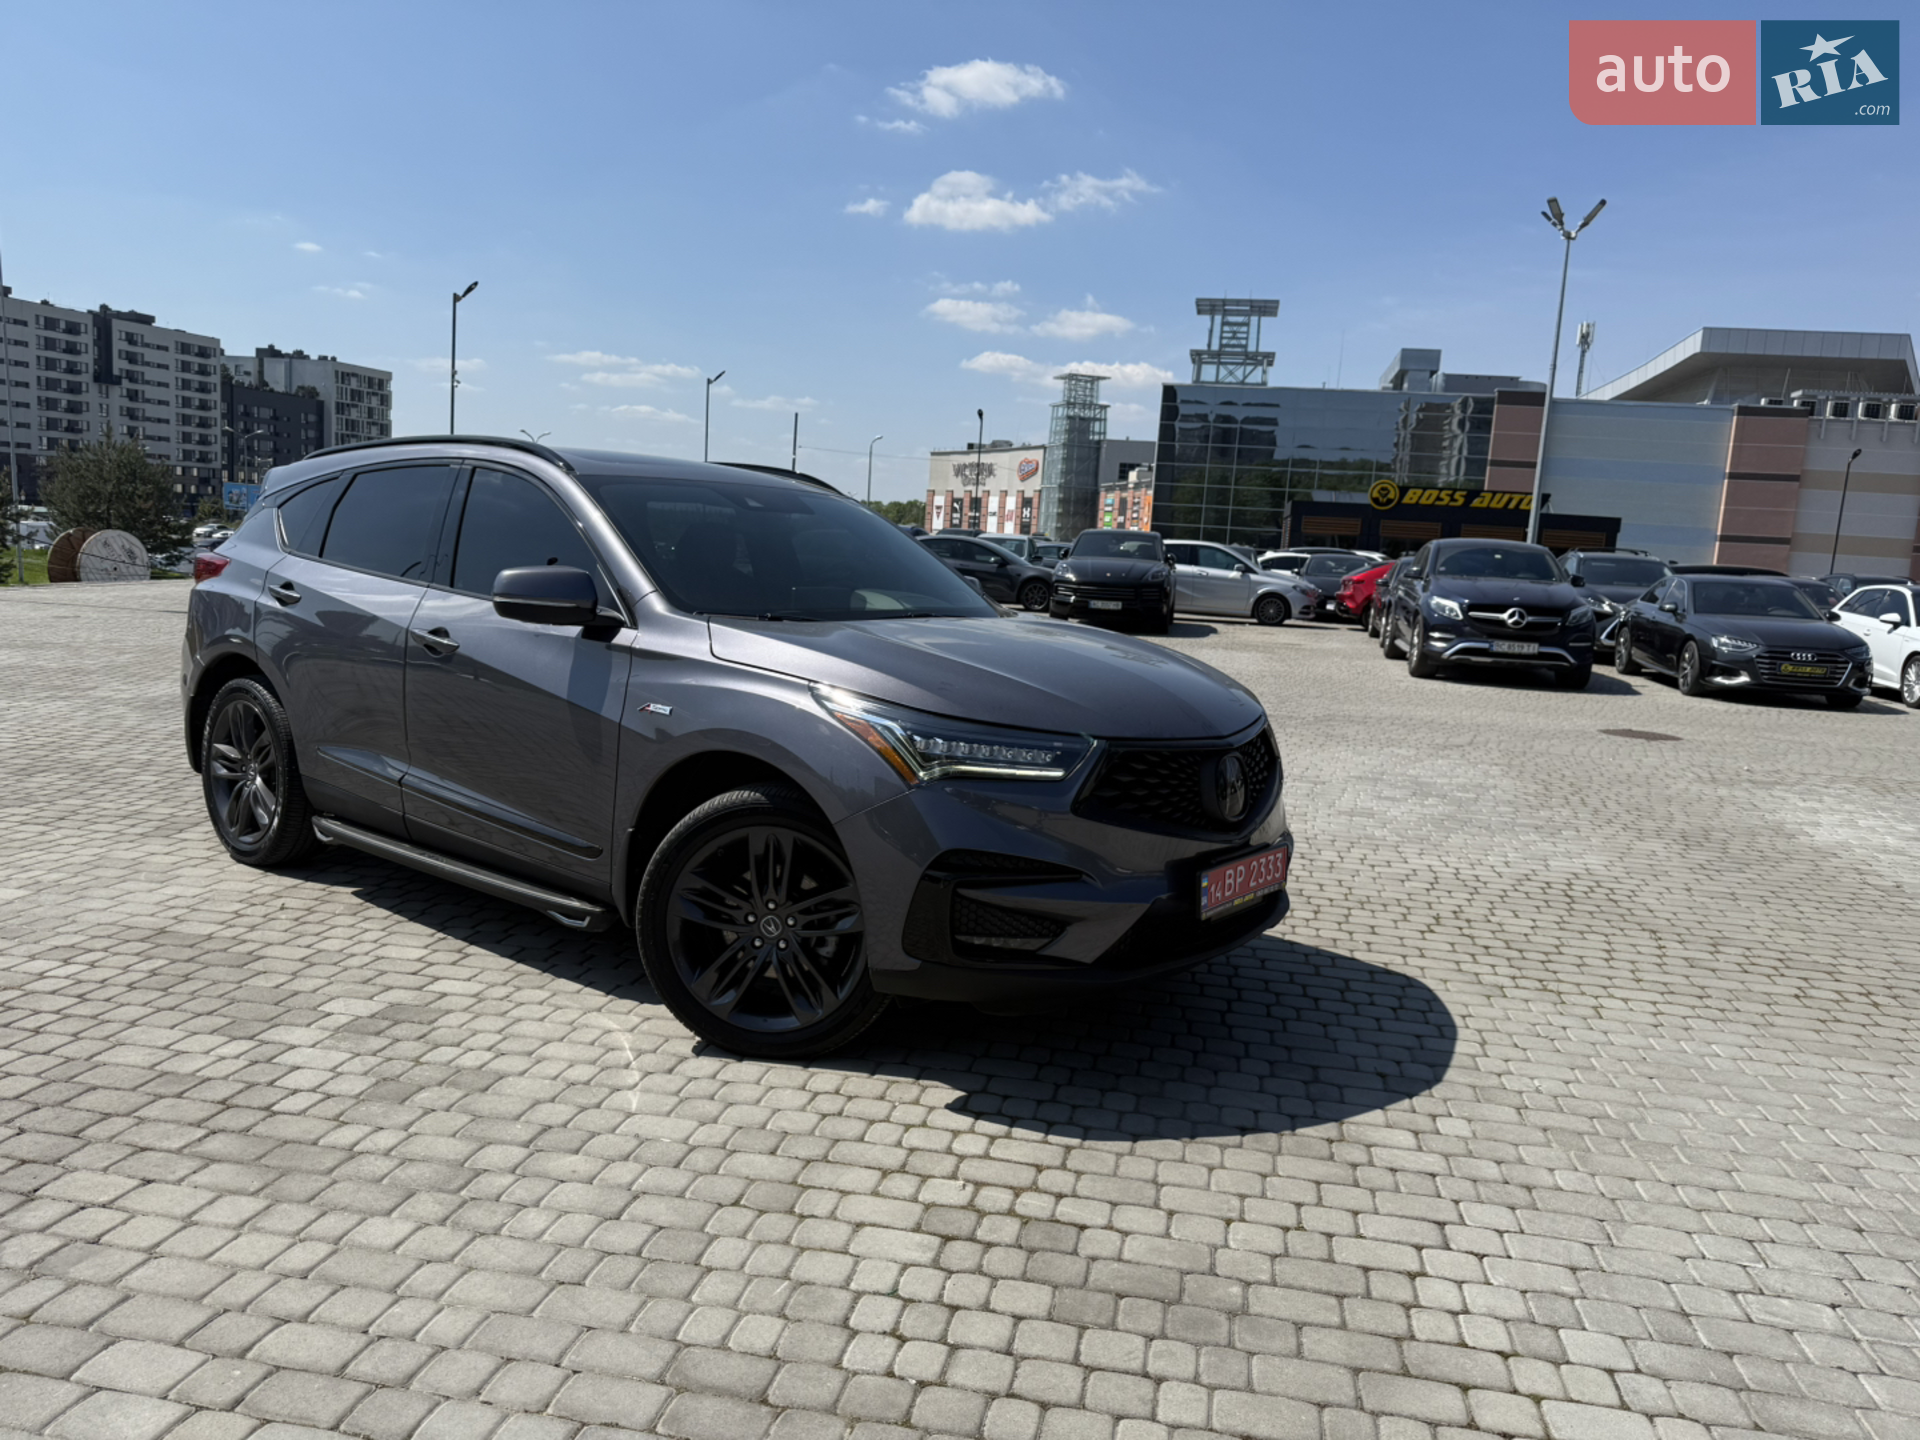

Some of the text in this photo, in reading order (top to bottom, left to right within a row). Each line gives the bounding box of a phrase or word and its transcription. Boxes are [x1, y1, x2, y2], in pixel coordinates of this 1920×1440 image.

[1402, 489, 1534, 511] BOSS AUTO
[1209, 881, 1222, 903] 14
[1224, 865, 1245, 896] BP
[1249, 853, 1282, 887] 2333
